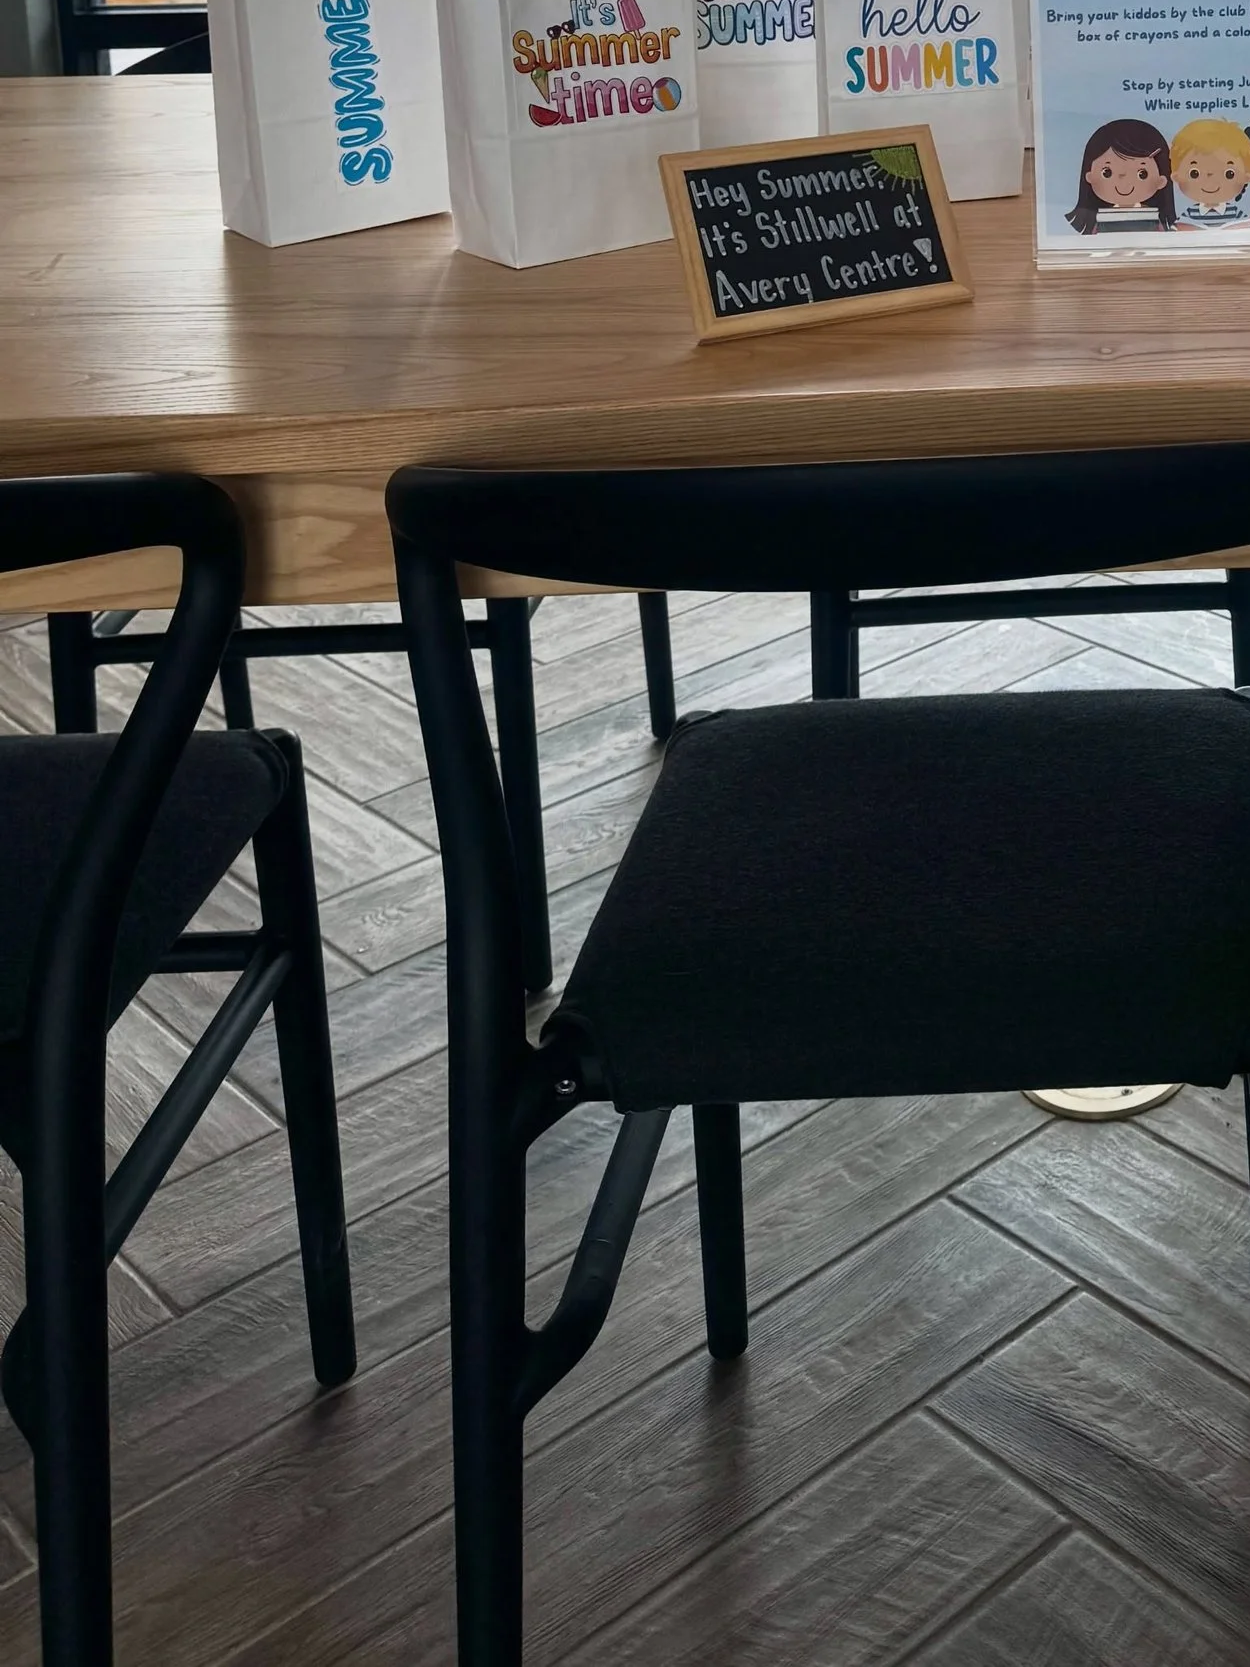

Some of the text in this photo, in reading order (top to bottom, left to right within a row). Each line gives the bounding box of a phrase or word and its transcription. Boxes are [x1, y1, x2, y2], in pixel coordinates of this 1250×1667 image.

[1046, 9, 1084, 25] Bring
[1087, 11, 1119, 26] your
[1123, 6, 1166, 20] kiddos
[1170, 6, 1188, 23] by
[1192, 5, 1214, 18] the
[1218, 4, 1246, 17] club
[1077, 29, 1101, 42] box
[1105, 29, 1120, 42] of
[1124, 30, 1179, 44] crayons
[1183, 26, 1209, 39] and
[1212, 28, 1221, 38] a
[513, 26, 681, 75] Summer
[845, 36, 1000, 94] SUMMER
[550, 71, 656, 125] time
[1122, 79, 1154, 94] Stop
[1157, 78, 1174, 94] by
[1179, 77, 1234, 91] starting
[1144, 99, 1181, 112] While
[1185, 97, 1238, 113] supplies
[689, 179, 752, 217] Hey
[700, 192, 922, 258] It's Stillwell at
[714, 237, 939, 312] Avery Centre!
